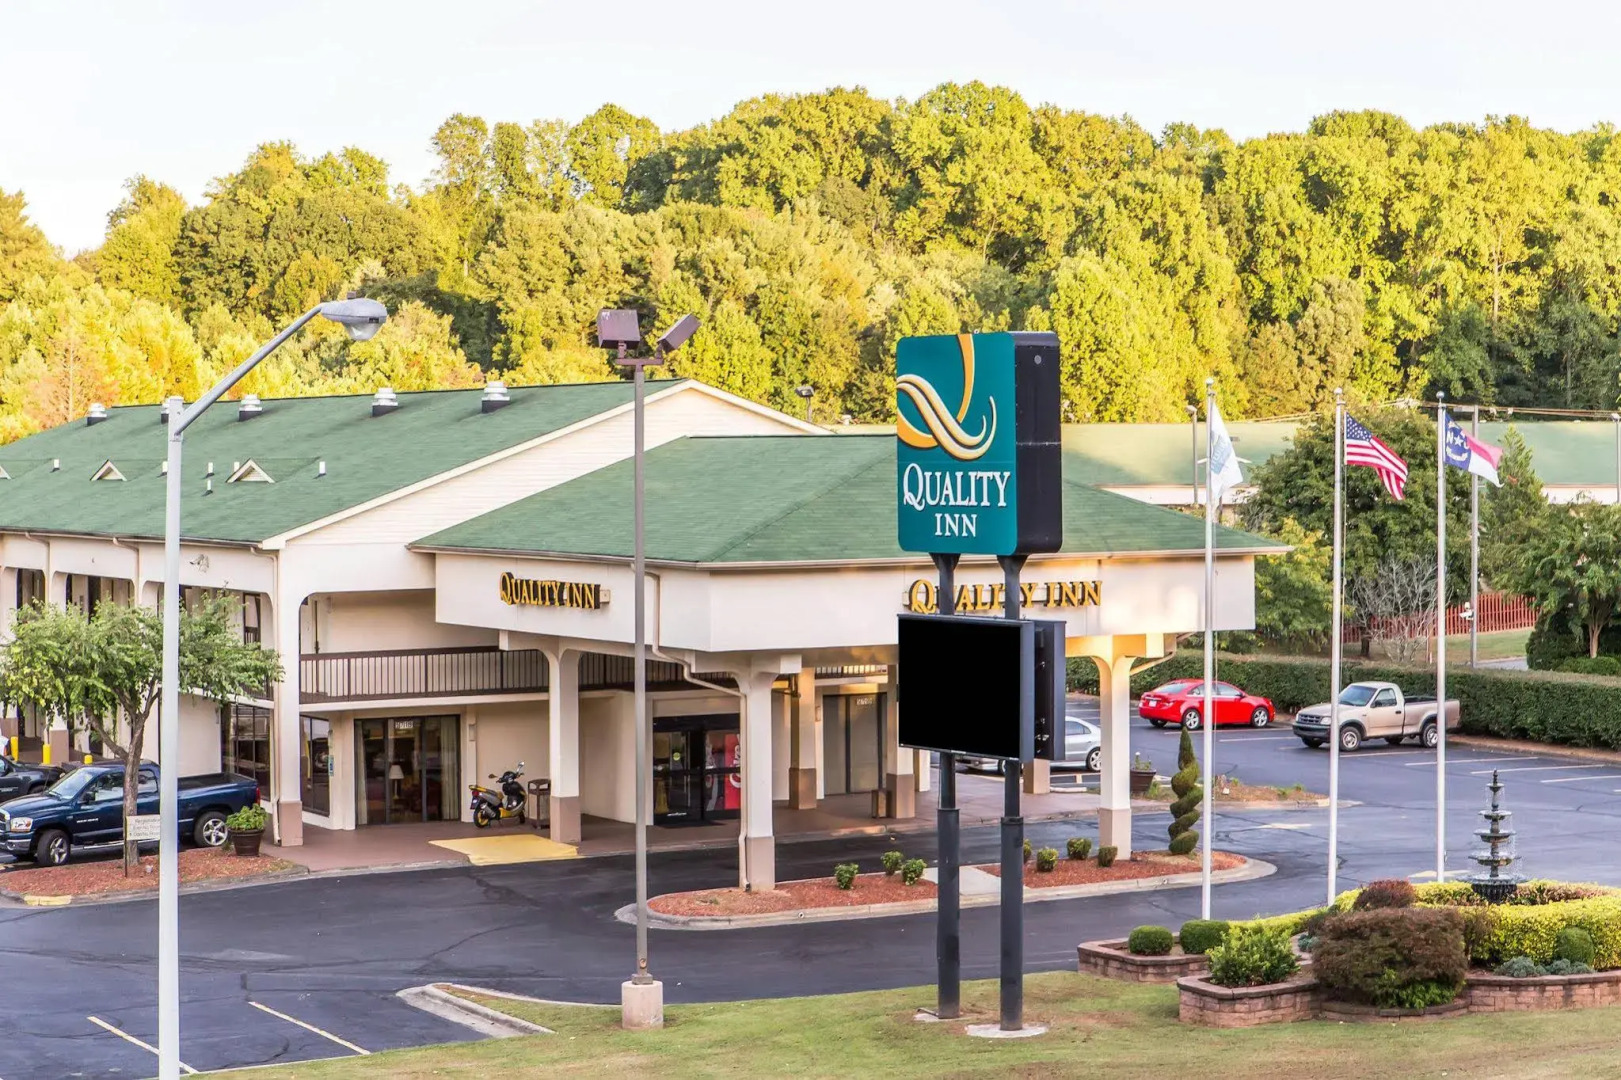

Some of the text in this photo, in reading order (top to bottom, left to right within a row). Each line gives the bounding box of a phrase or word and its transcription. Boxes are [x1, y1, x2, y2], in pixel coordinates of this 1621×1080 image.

[903, 463, 1011, 511] QUALITY
[934, 513, 977, 537] INN
[500, 572, 601, 609] QUALITY INN
[909, 579, 1103, 615] QALIY INN
